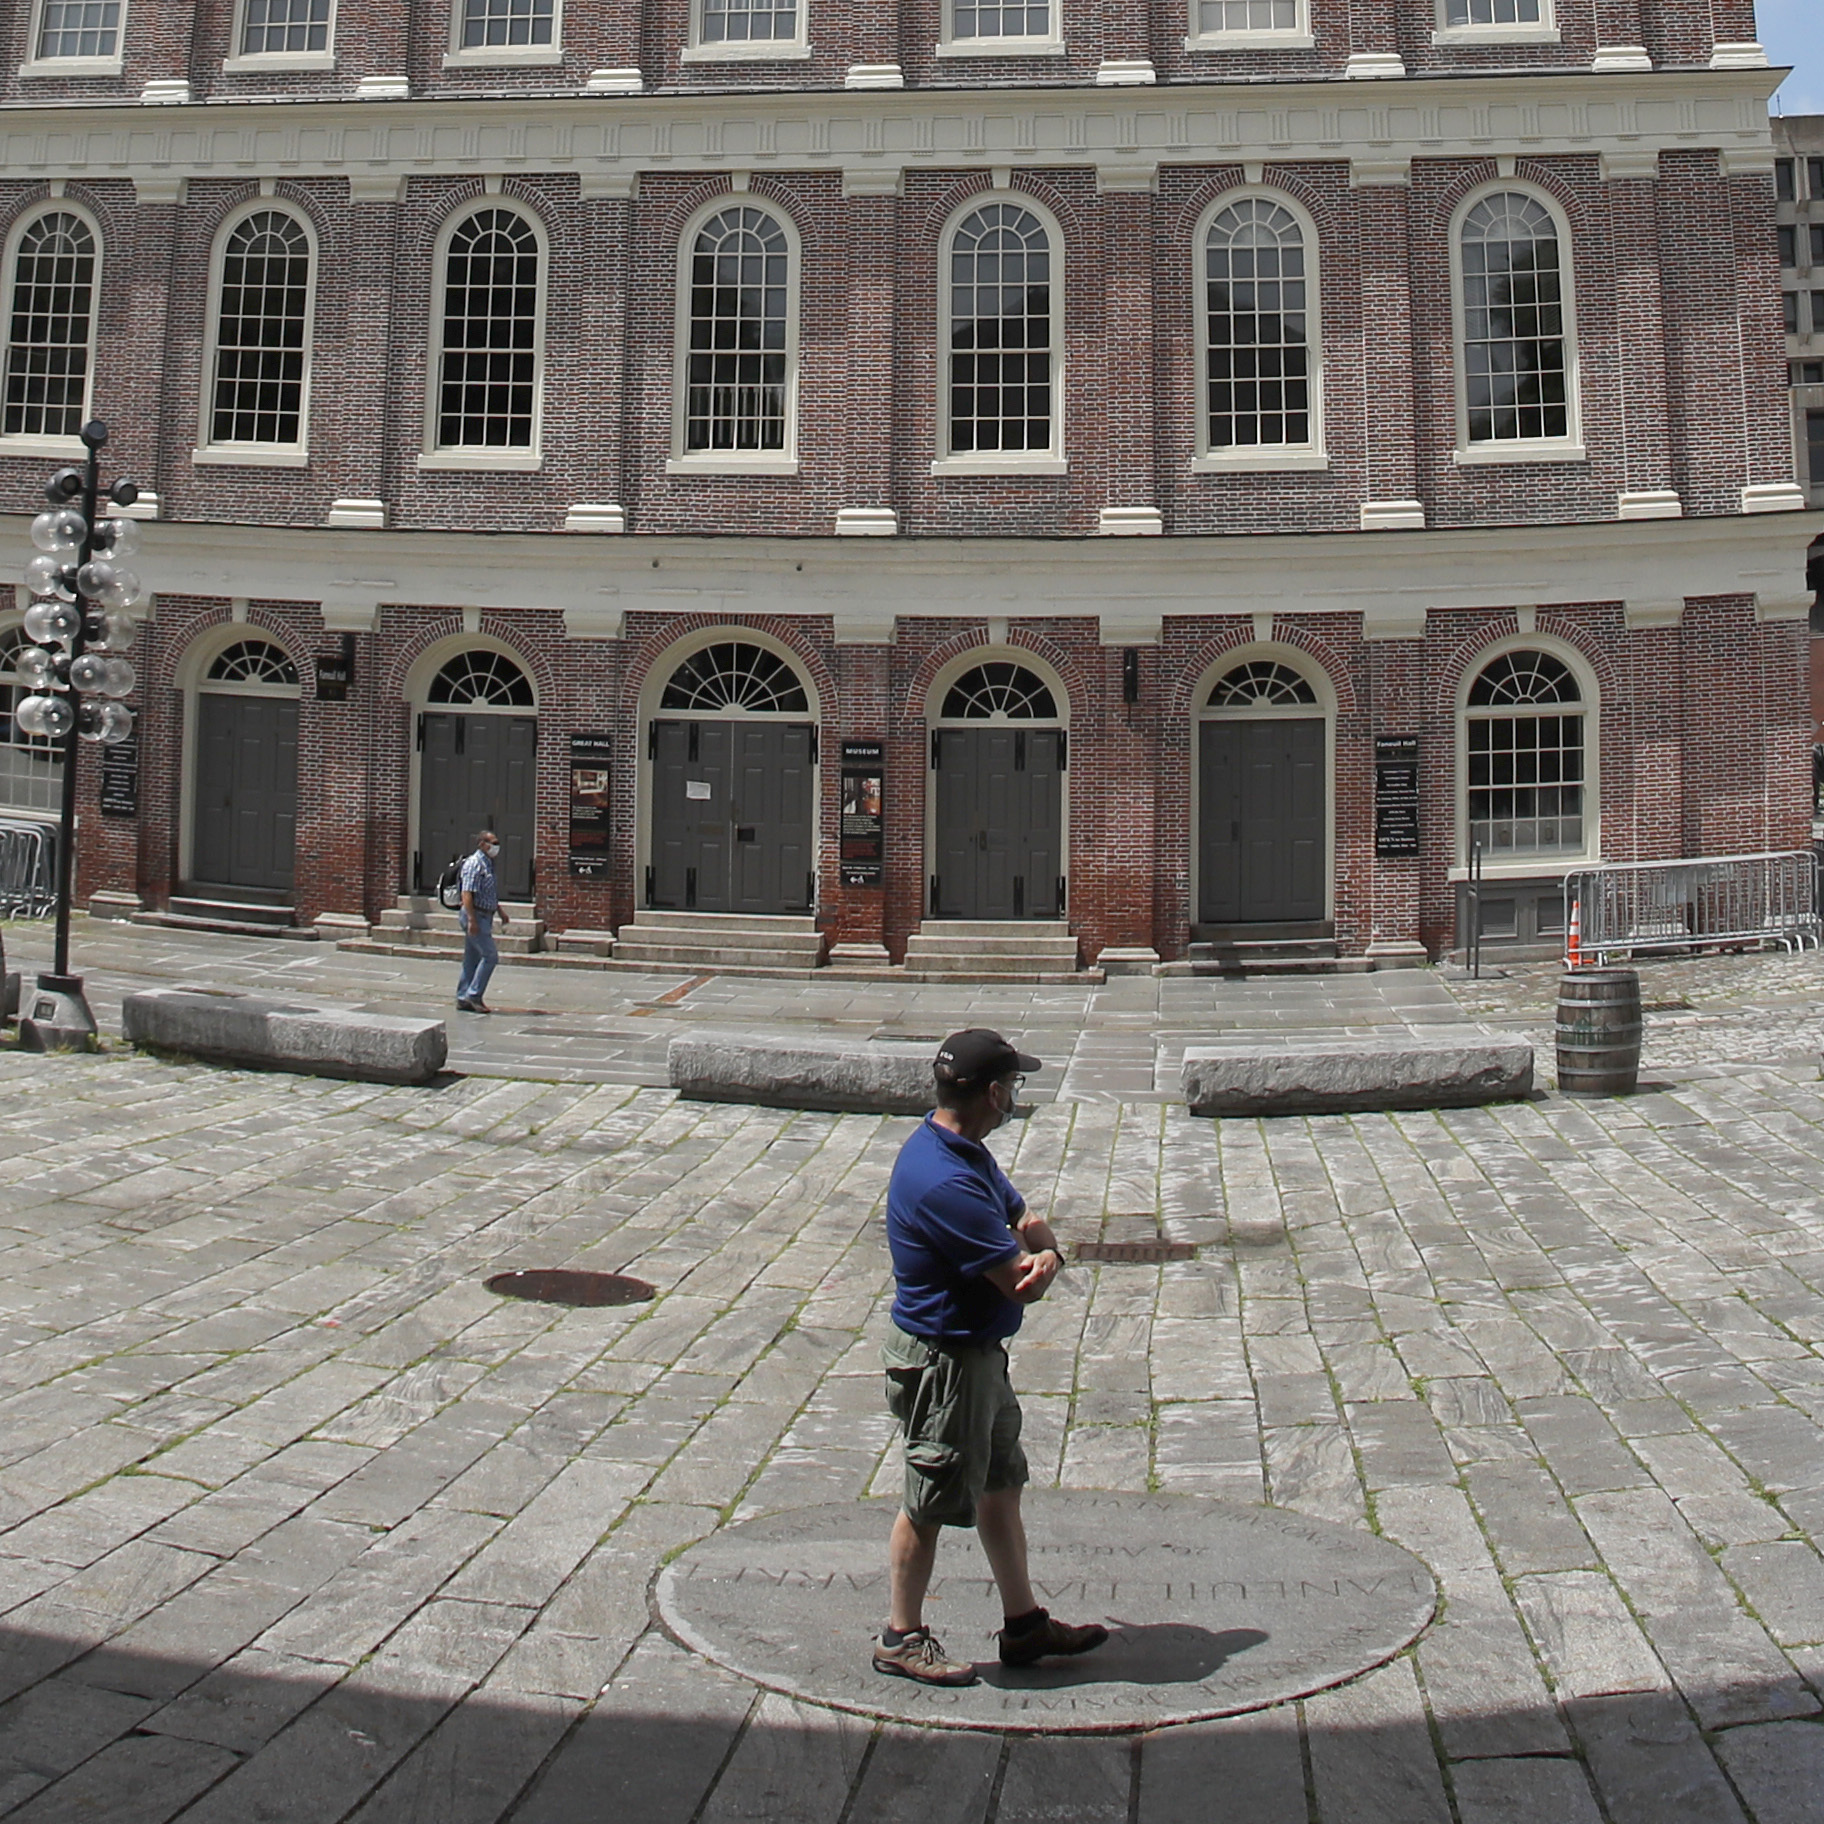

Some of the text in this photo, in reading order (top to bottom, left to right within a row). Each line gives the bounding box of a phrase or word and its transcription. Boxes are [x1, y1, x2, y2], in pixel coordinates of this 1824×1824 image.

[593, 740, 610, 748] HALL
[1403, 739, 1416, 747] Hall
[845, 747, 880, 755] MUSEUM
[960, 1578, 1122, 1601] HAL
[1001, 1690, 1175, 1711] JOSIAH
